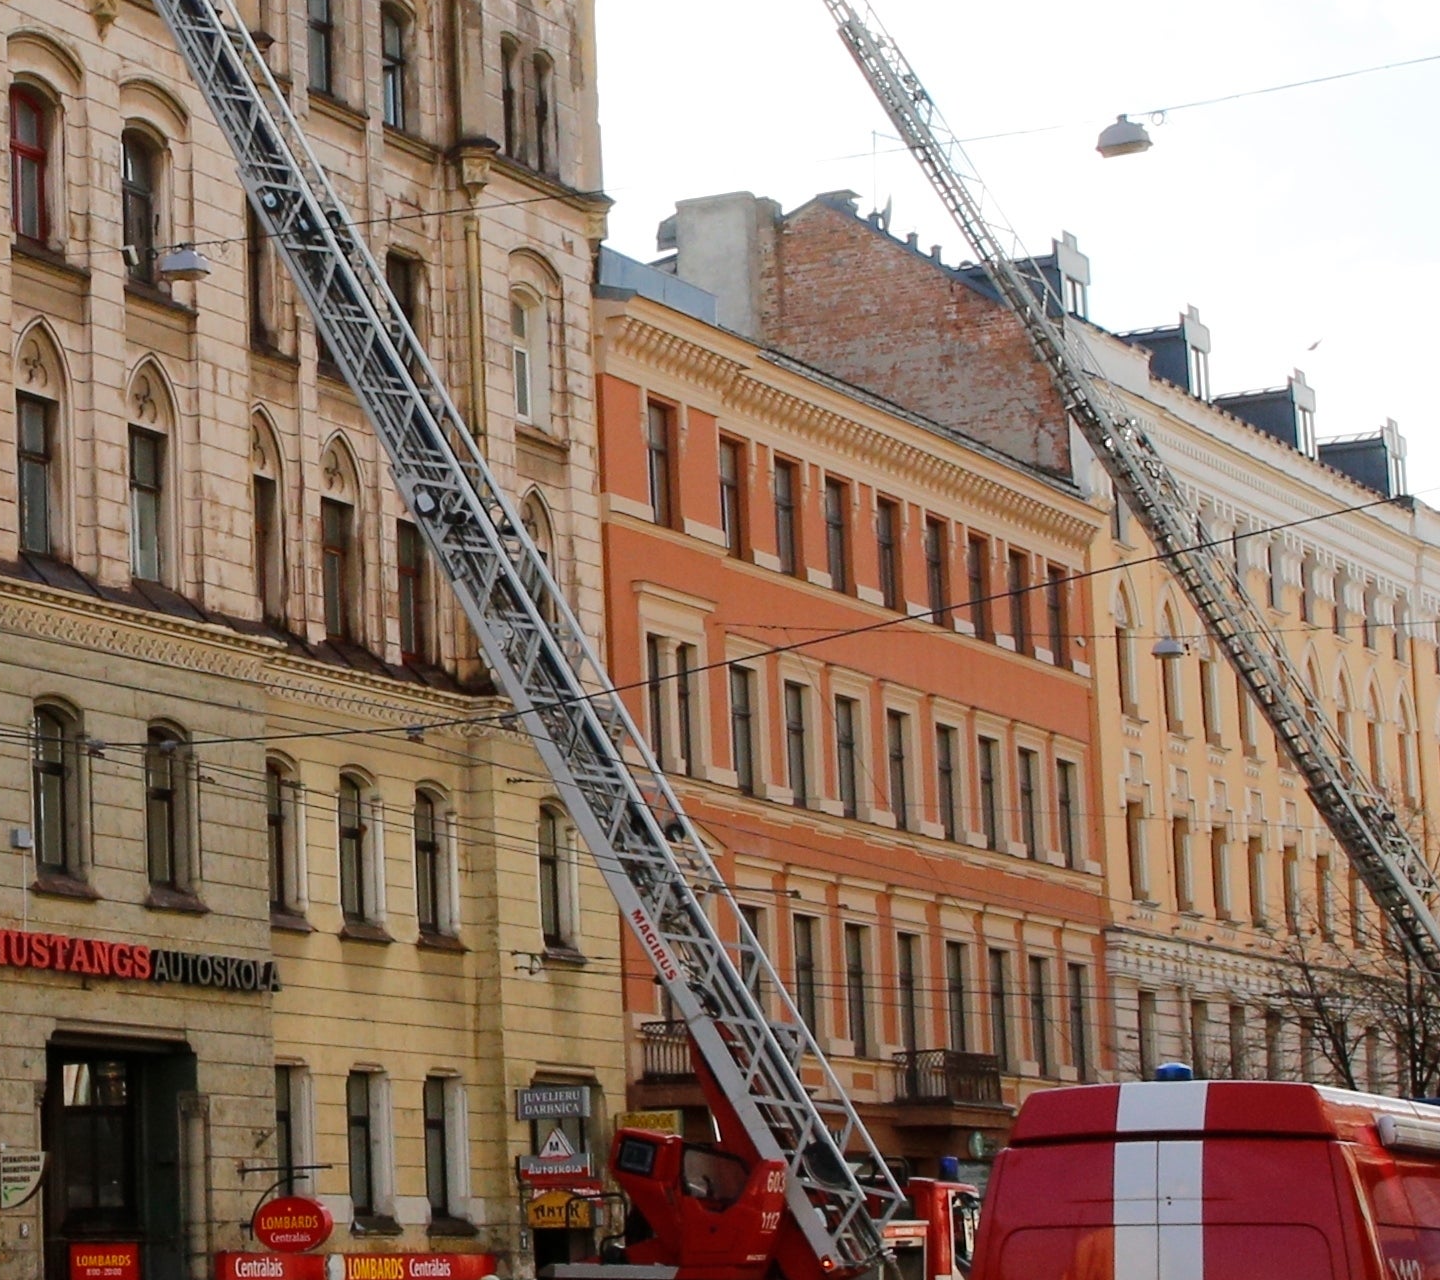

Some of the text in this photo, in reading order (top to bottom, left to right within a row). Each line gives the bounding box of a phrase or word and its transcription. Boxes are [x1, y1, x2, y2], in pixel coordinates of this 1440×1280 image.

[631, 908, 677, 981] MAGIRUS
[152, 949, 283, 992] AUTOSKOLA
[523, 1090, 581, 1104] JUVELIERU
[524, 1104, 580, 1115] DARBNĪCA
[549, 1141, 559, 1151] M
[533, 1201, 581, 1219] ANTK
[261, 1215, 319, 1229] LOMBARDS
[76, 1254, 132, 1267] LOMBARDS
[348, 1258, 404, 1280] LOMBARDS
